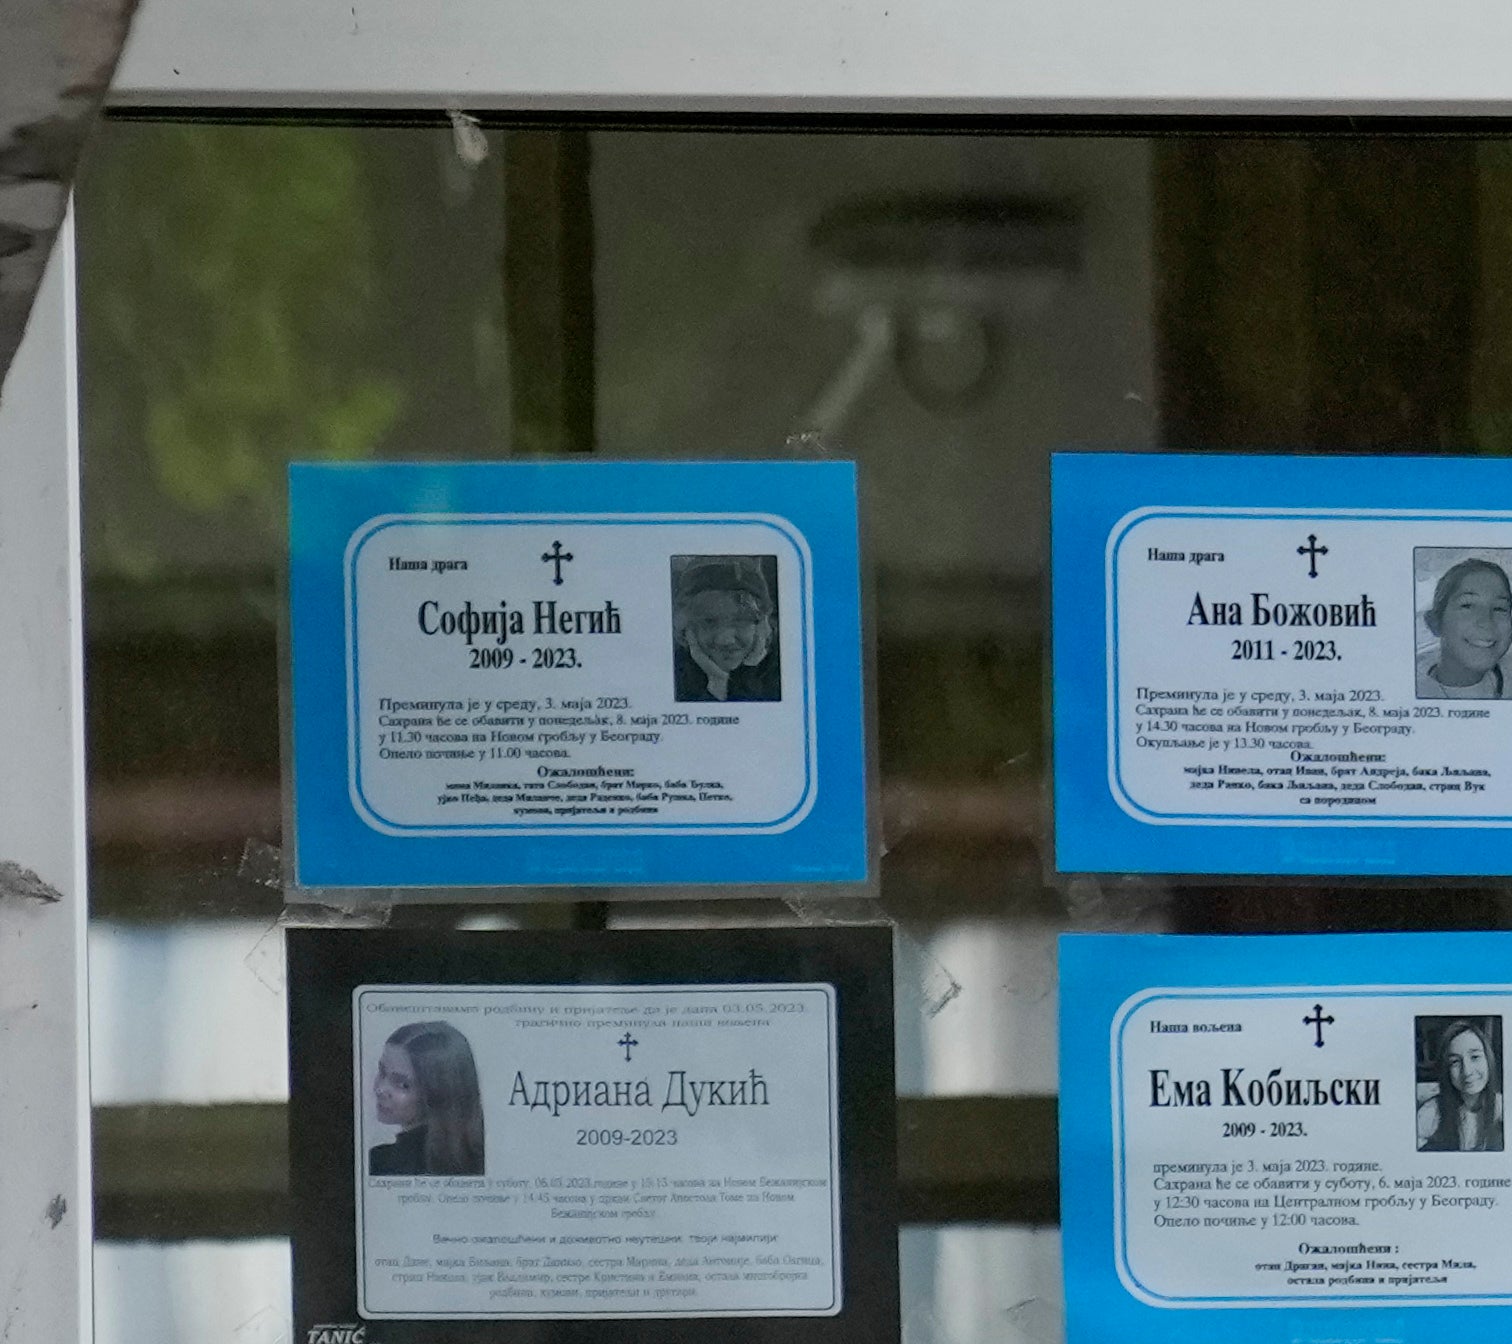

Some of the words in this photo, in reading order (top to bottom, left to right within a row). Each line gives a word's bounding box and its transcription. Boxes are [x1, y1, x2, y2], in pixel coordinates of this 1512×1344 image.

[388, 556, 428, 571] Наша
[431, 560, 468, 575] драга
[1147, 547, 1185, 562] Наша
[1188, 552, 1225, 566] драга
[1187, 592, 1243, 626] Ана
[1250, 592, 1376, 627] Божовић
[418, 600, 525, 646] Софија
[532, 600, 621, 635] Негић
[469, 647, 514, 670] 2009
[532, 647, 582, 669] 2023.
[1231, 639, 1274, 661] 2011
[1293, 640, 1342, 661] 2023.
[1150, 1020, 1188, 1034] Наша
[1192, 1023, 1242, 1033] вољена
[508, 1070, 653, 1118] Адриана
[661, 1068, 769, 1118] Дукић
[1149, 1069, 1212, 1107] Ема
[1220, 1067, 1380, 1107] Кобиљски
[576, 1128, 677, 1146] 2009-2023
[1222, 1122, 1256, 1138] 2009
[1270, 1121, 1307, 1138] 2023.
[1152, 1163, 1228, 1178] преминула
[1230, 1160, 1243, 1176] је
[1247, 1159, 1258, 1173] 3.
[1262, 1159, 1291, 1176] маја
[1294, 1159, 1328, 1173] 2023.
[1215, 1176, 1231, 1191] ће
[1234, 1180, 1249, 1190] се
[1313, 1179, 1321, 1193] у
[1378, 1175, 1390, 1189] 6.
[1393, 1175, 1423, 1193] маја
[1426, 1175, 1460, 1189] 2023.
[1464, 1178, 1511, 1189] године
